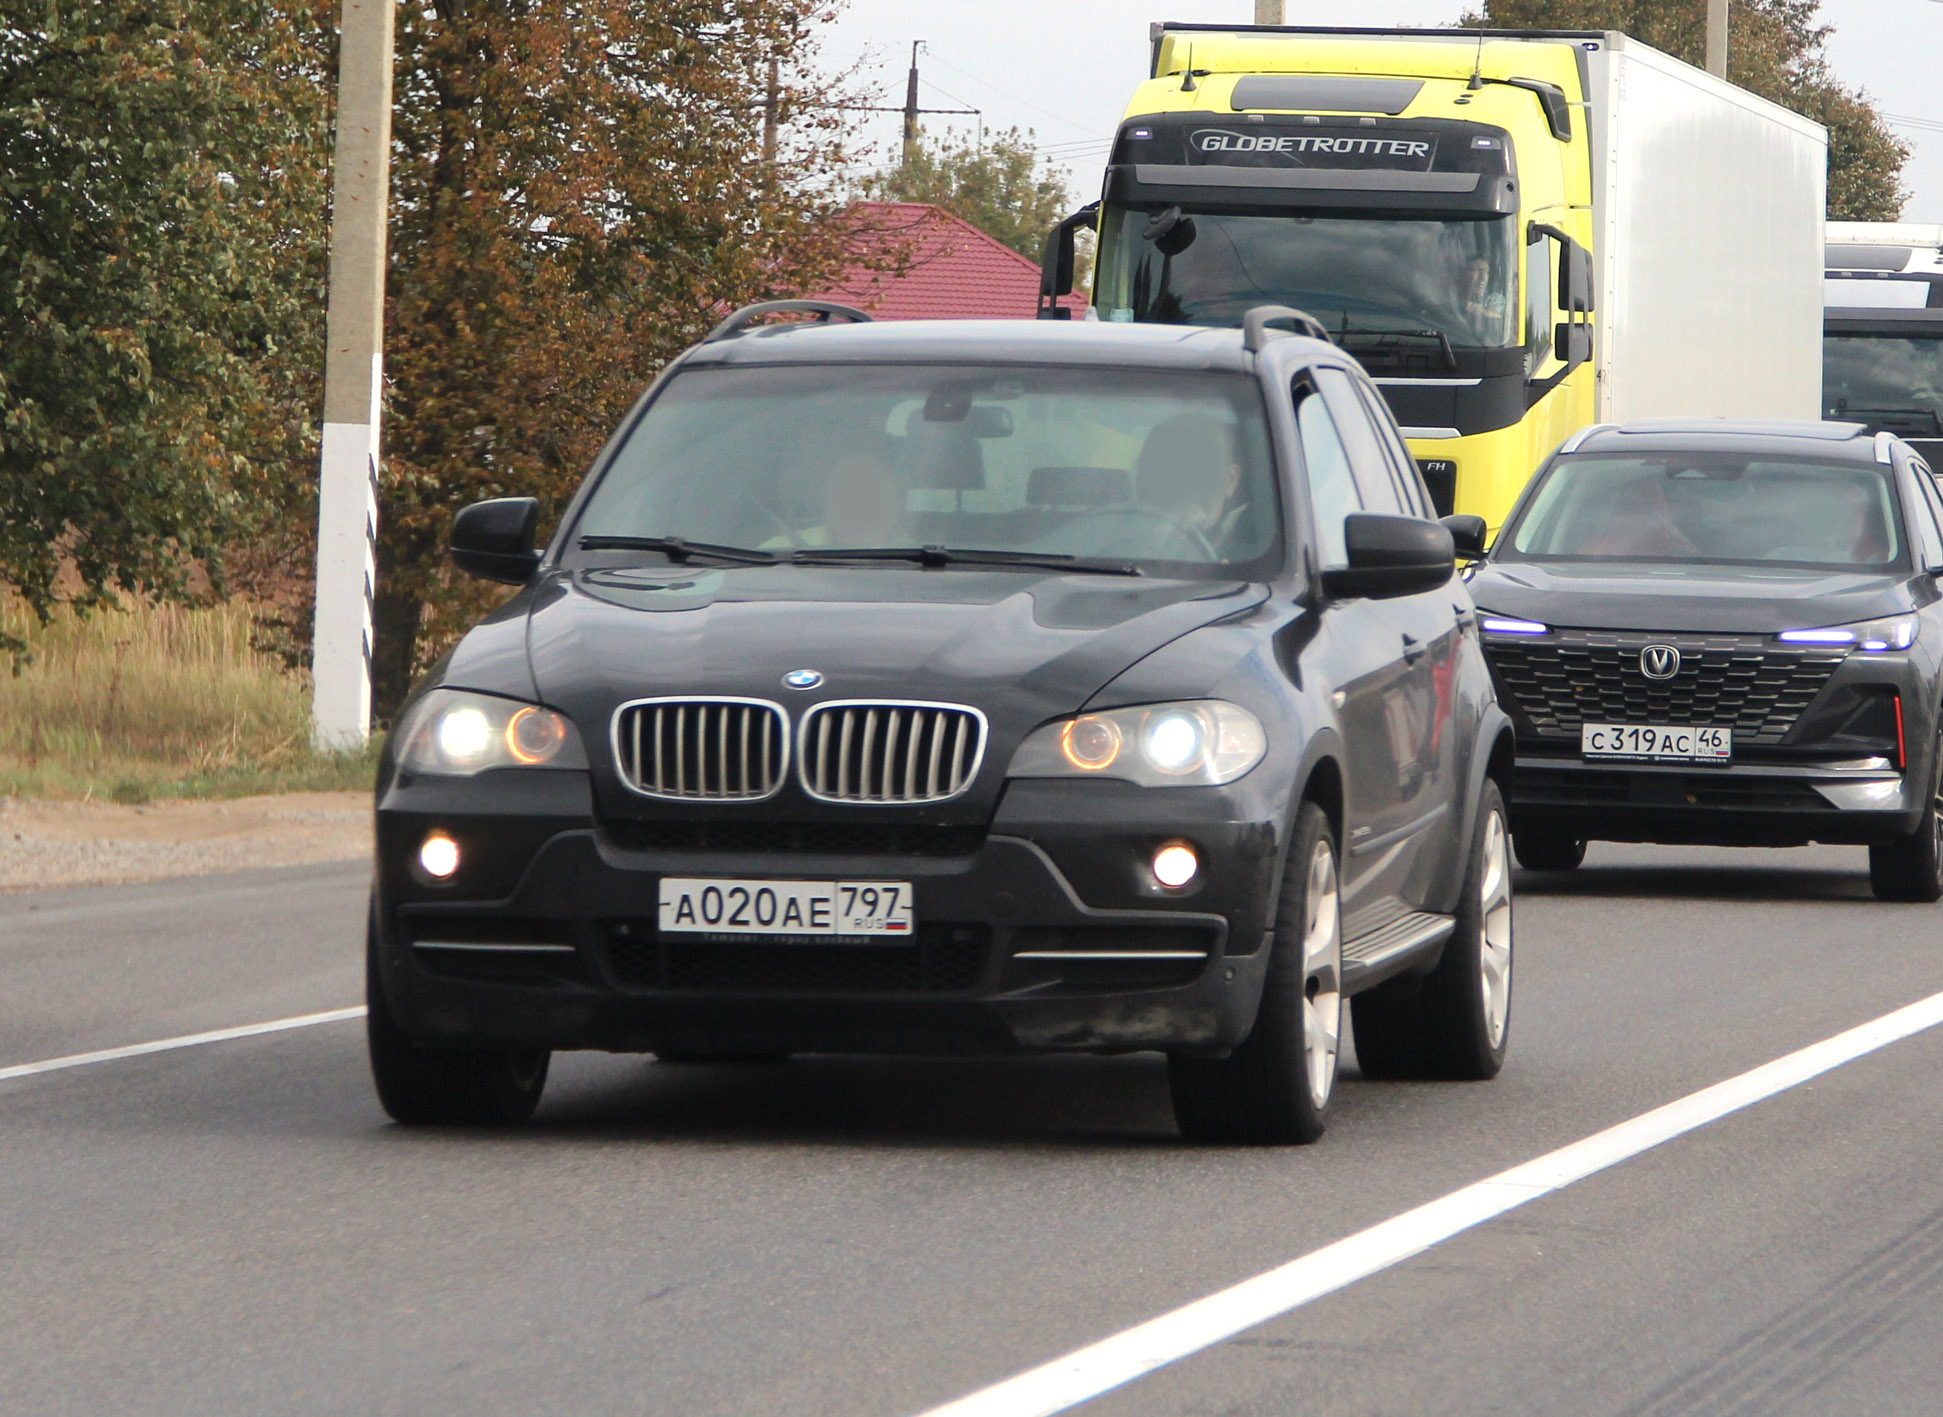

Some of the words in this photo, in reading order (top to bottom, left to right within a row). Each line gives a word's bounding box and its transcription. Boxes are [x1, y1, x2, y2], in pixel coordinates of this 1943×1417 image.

[1201, 135, 1430, 157] GLOBETROTTER
[1427, 462, 1446, 471] FH
[1699, 729, 1722, 747] 46
[1697, 747, 1715, 755] RUS
[840, 886, 900, 918] 797
[854, 918, 884, 929] RUS
